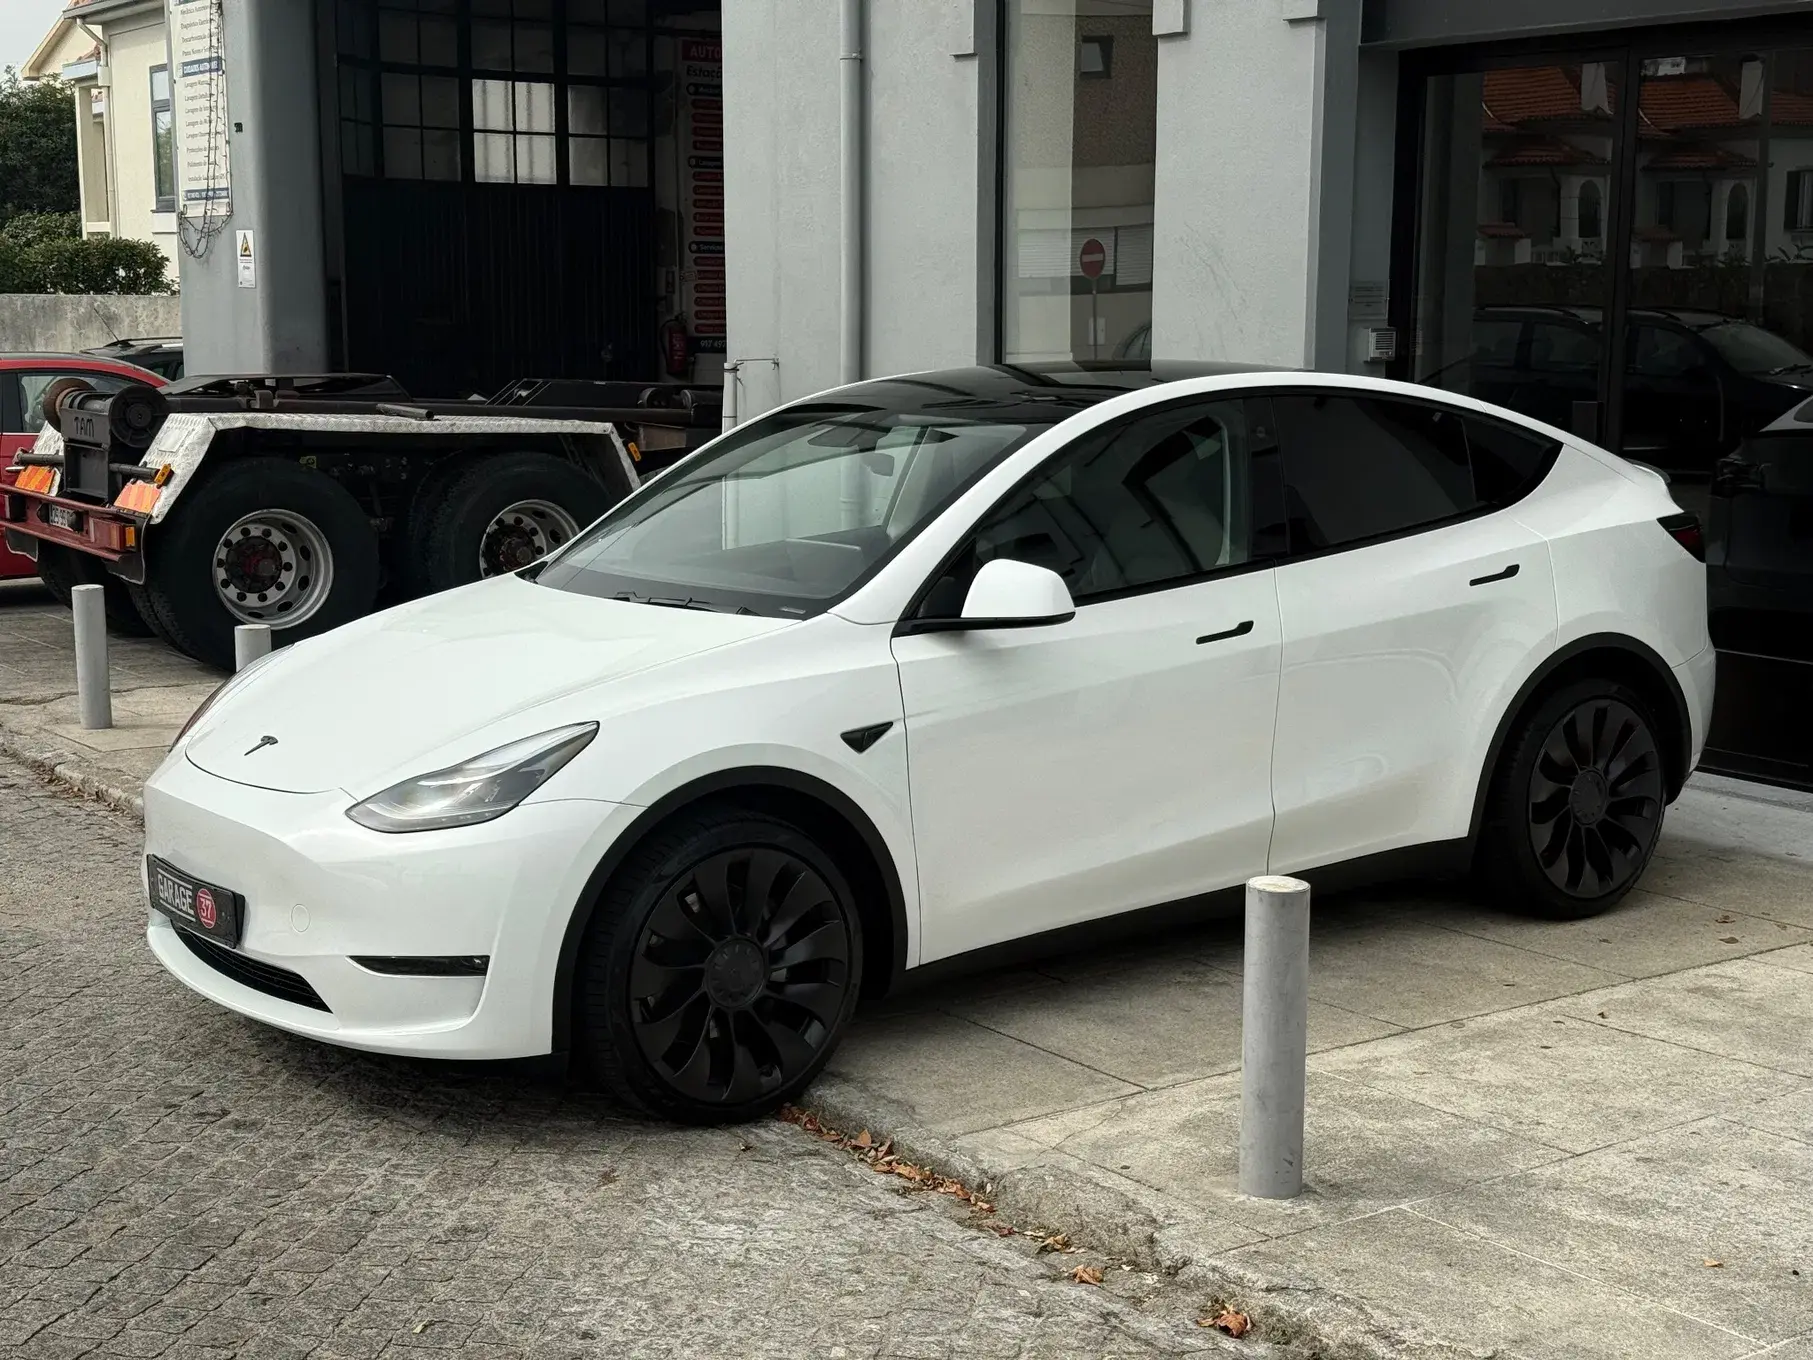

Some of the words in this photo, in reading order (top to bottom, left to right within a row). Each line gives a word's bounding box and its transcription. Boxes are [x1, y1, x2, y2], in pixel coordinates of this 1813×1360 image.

[690, 44, 722, 60] AUTO
[73, 416, 95, 439] TAM
[157, 874, 195, 915] GARAGE
[199, 898, 212, 920] 37
